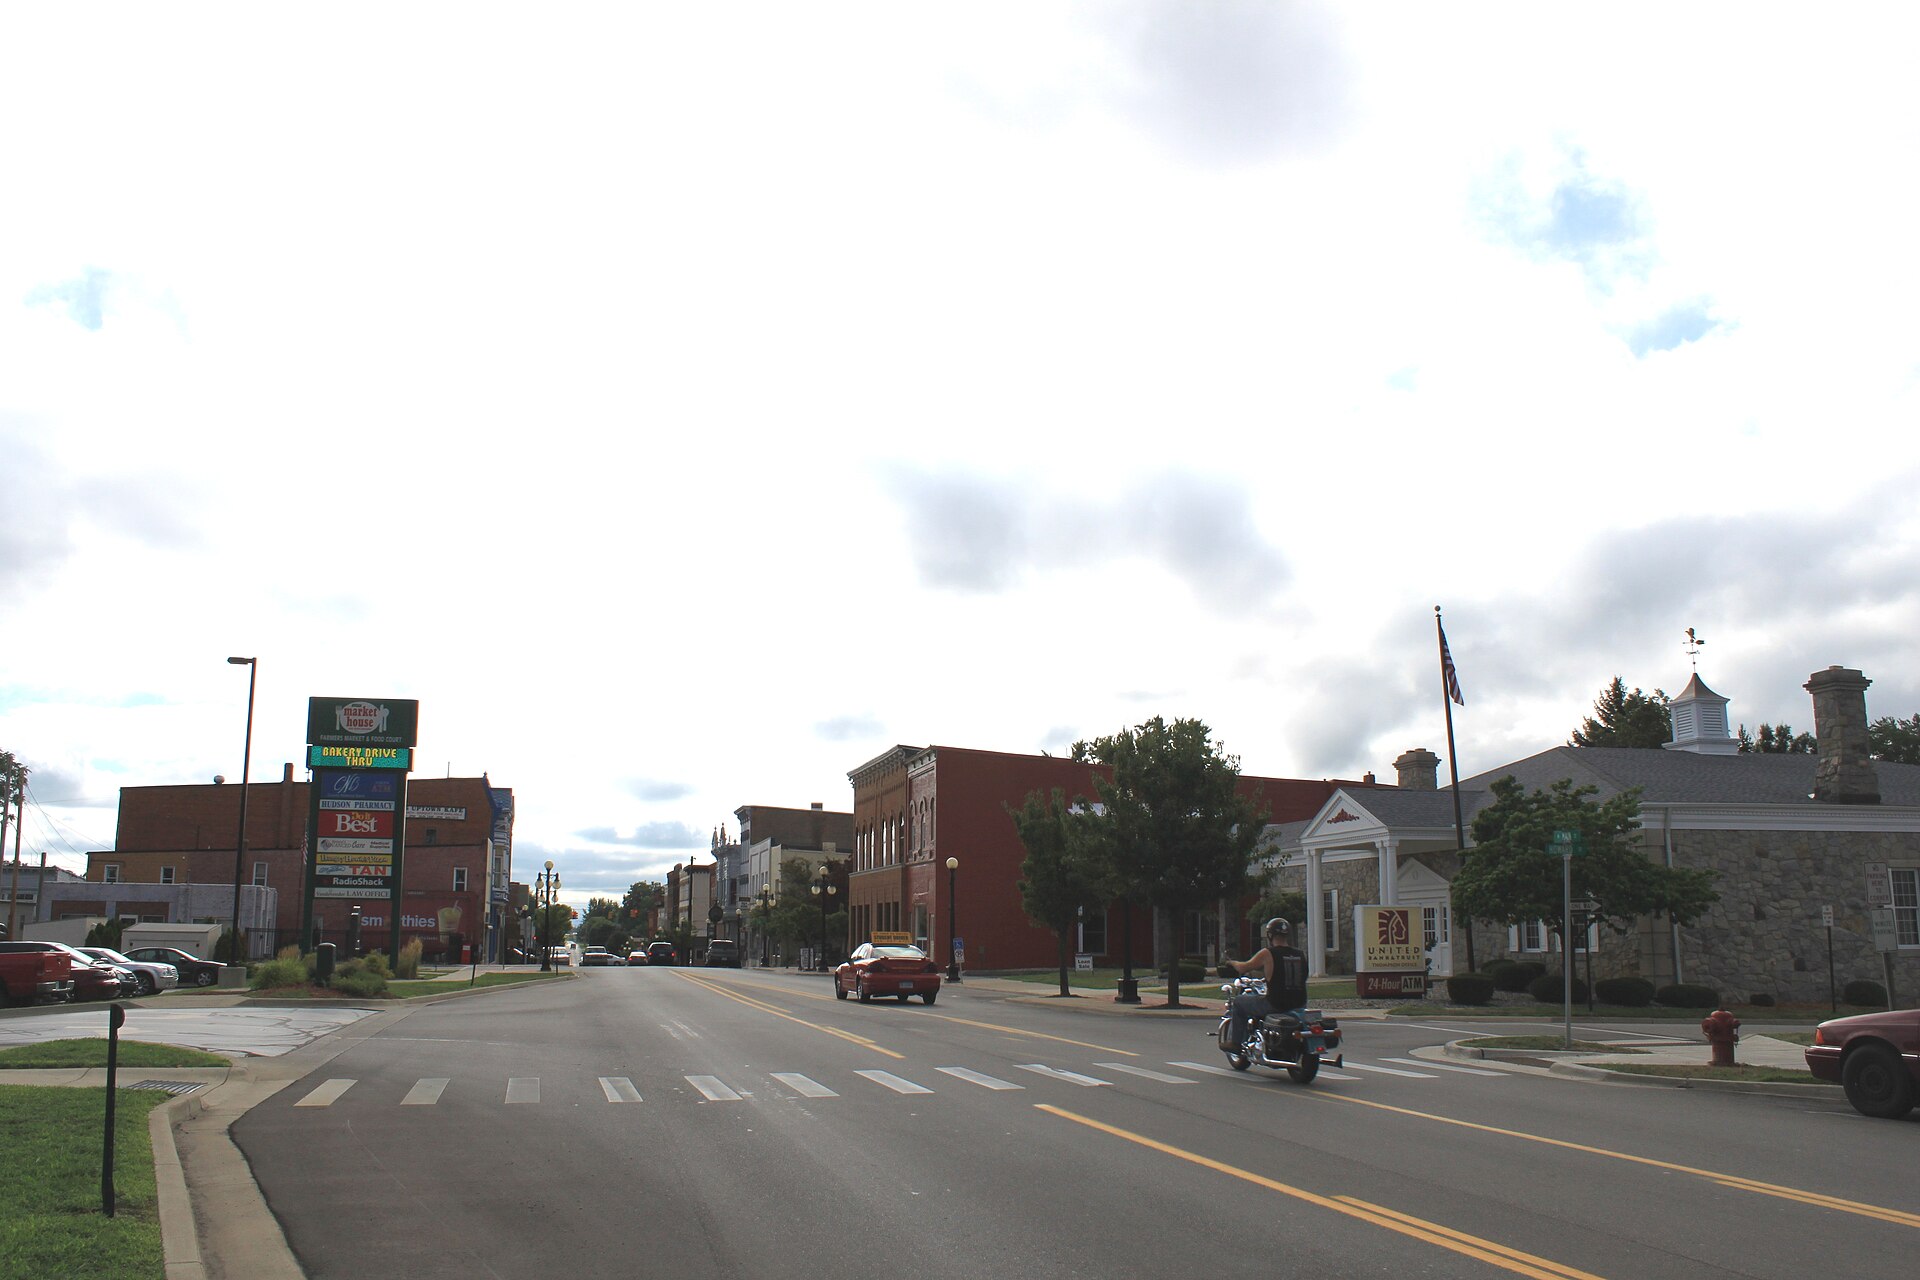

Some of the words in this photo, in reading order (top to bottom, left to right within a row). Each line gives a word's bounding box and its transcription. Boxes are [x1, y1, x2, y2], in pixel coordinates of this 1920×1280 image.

[344, 706, 377, 717] market
[347, 717, 374, 727] house
[320, 734, 343, 742] FARMERS
[322, 747, 361, 757] BAKERY
[365, 748, 397, 758] DRIVE
[345, 756, 374, 766] THRU
[321, 800, 351, 809] HUDSON
[354, 801, 393, 810] PHARMACY
[335, 813, 378, 833] Best
[349, 865, 387, 876] TAN
[332, 877, 383, 886] RadioShack
[346, 889, 364, 897] LAW
[364, 889, 389, 897] OFFICE
[1367, 977, 1400, 991] 24-Hour
[1402, 977, 1423, 990] ATM
